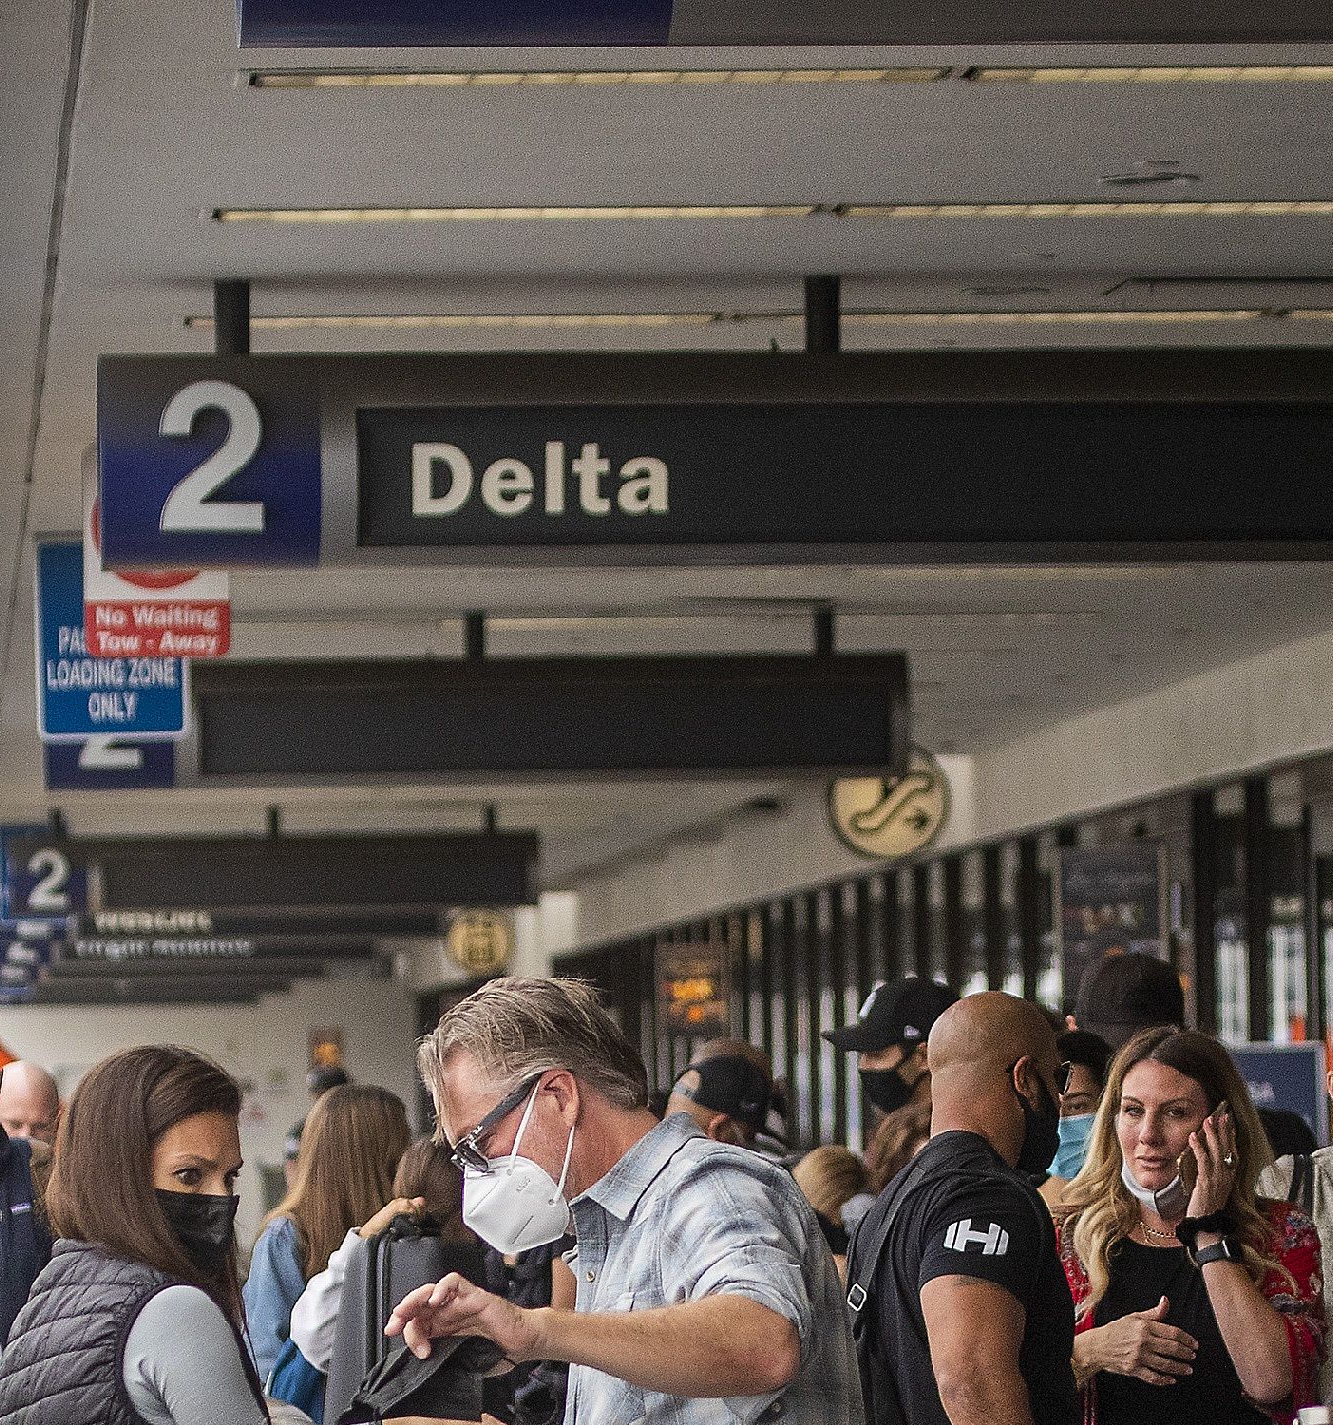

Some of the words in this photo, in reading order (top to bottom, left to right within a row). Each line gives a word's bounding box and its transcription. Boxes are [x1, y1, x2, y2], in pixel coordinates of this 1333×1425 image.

[159, 379, 264, 534] 2
[412, 440, 669, 517] Delta
[95, 605, 127, 626] No
[133, 605, 219, 630] Waiting
[96, 631, 140, 651] Tow
[158, 630, 219, 654] Away
[47, 658, 124, 690] LOADING
[127, 656, 177, 687] ZONE
[88, 692, 138, 723] ONLY
[27, 848, 70, 911] 2
